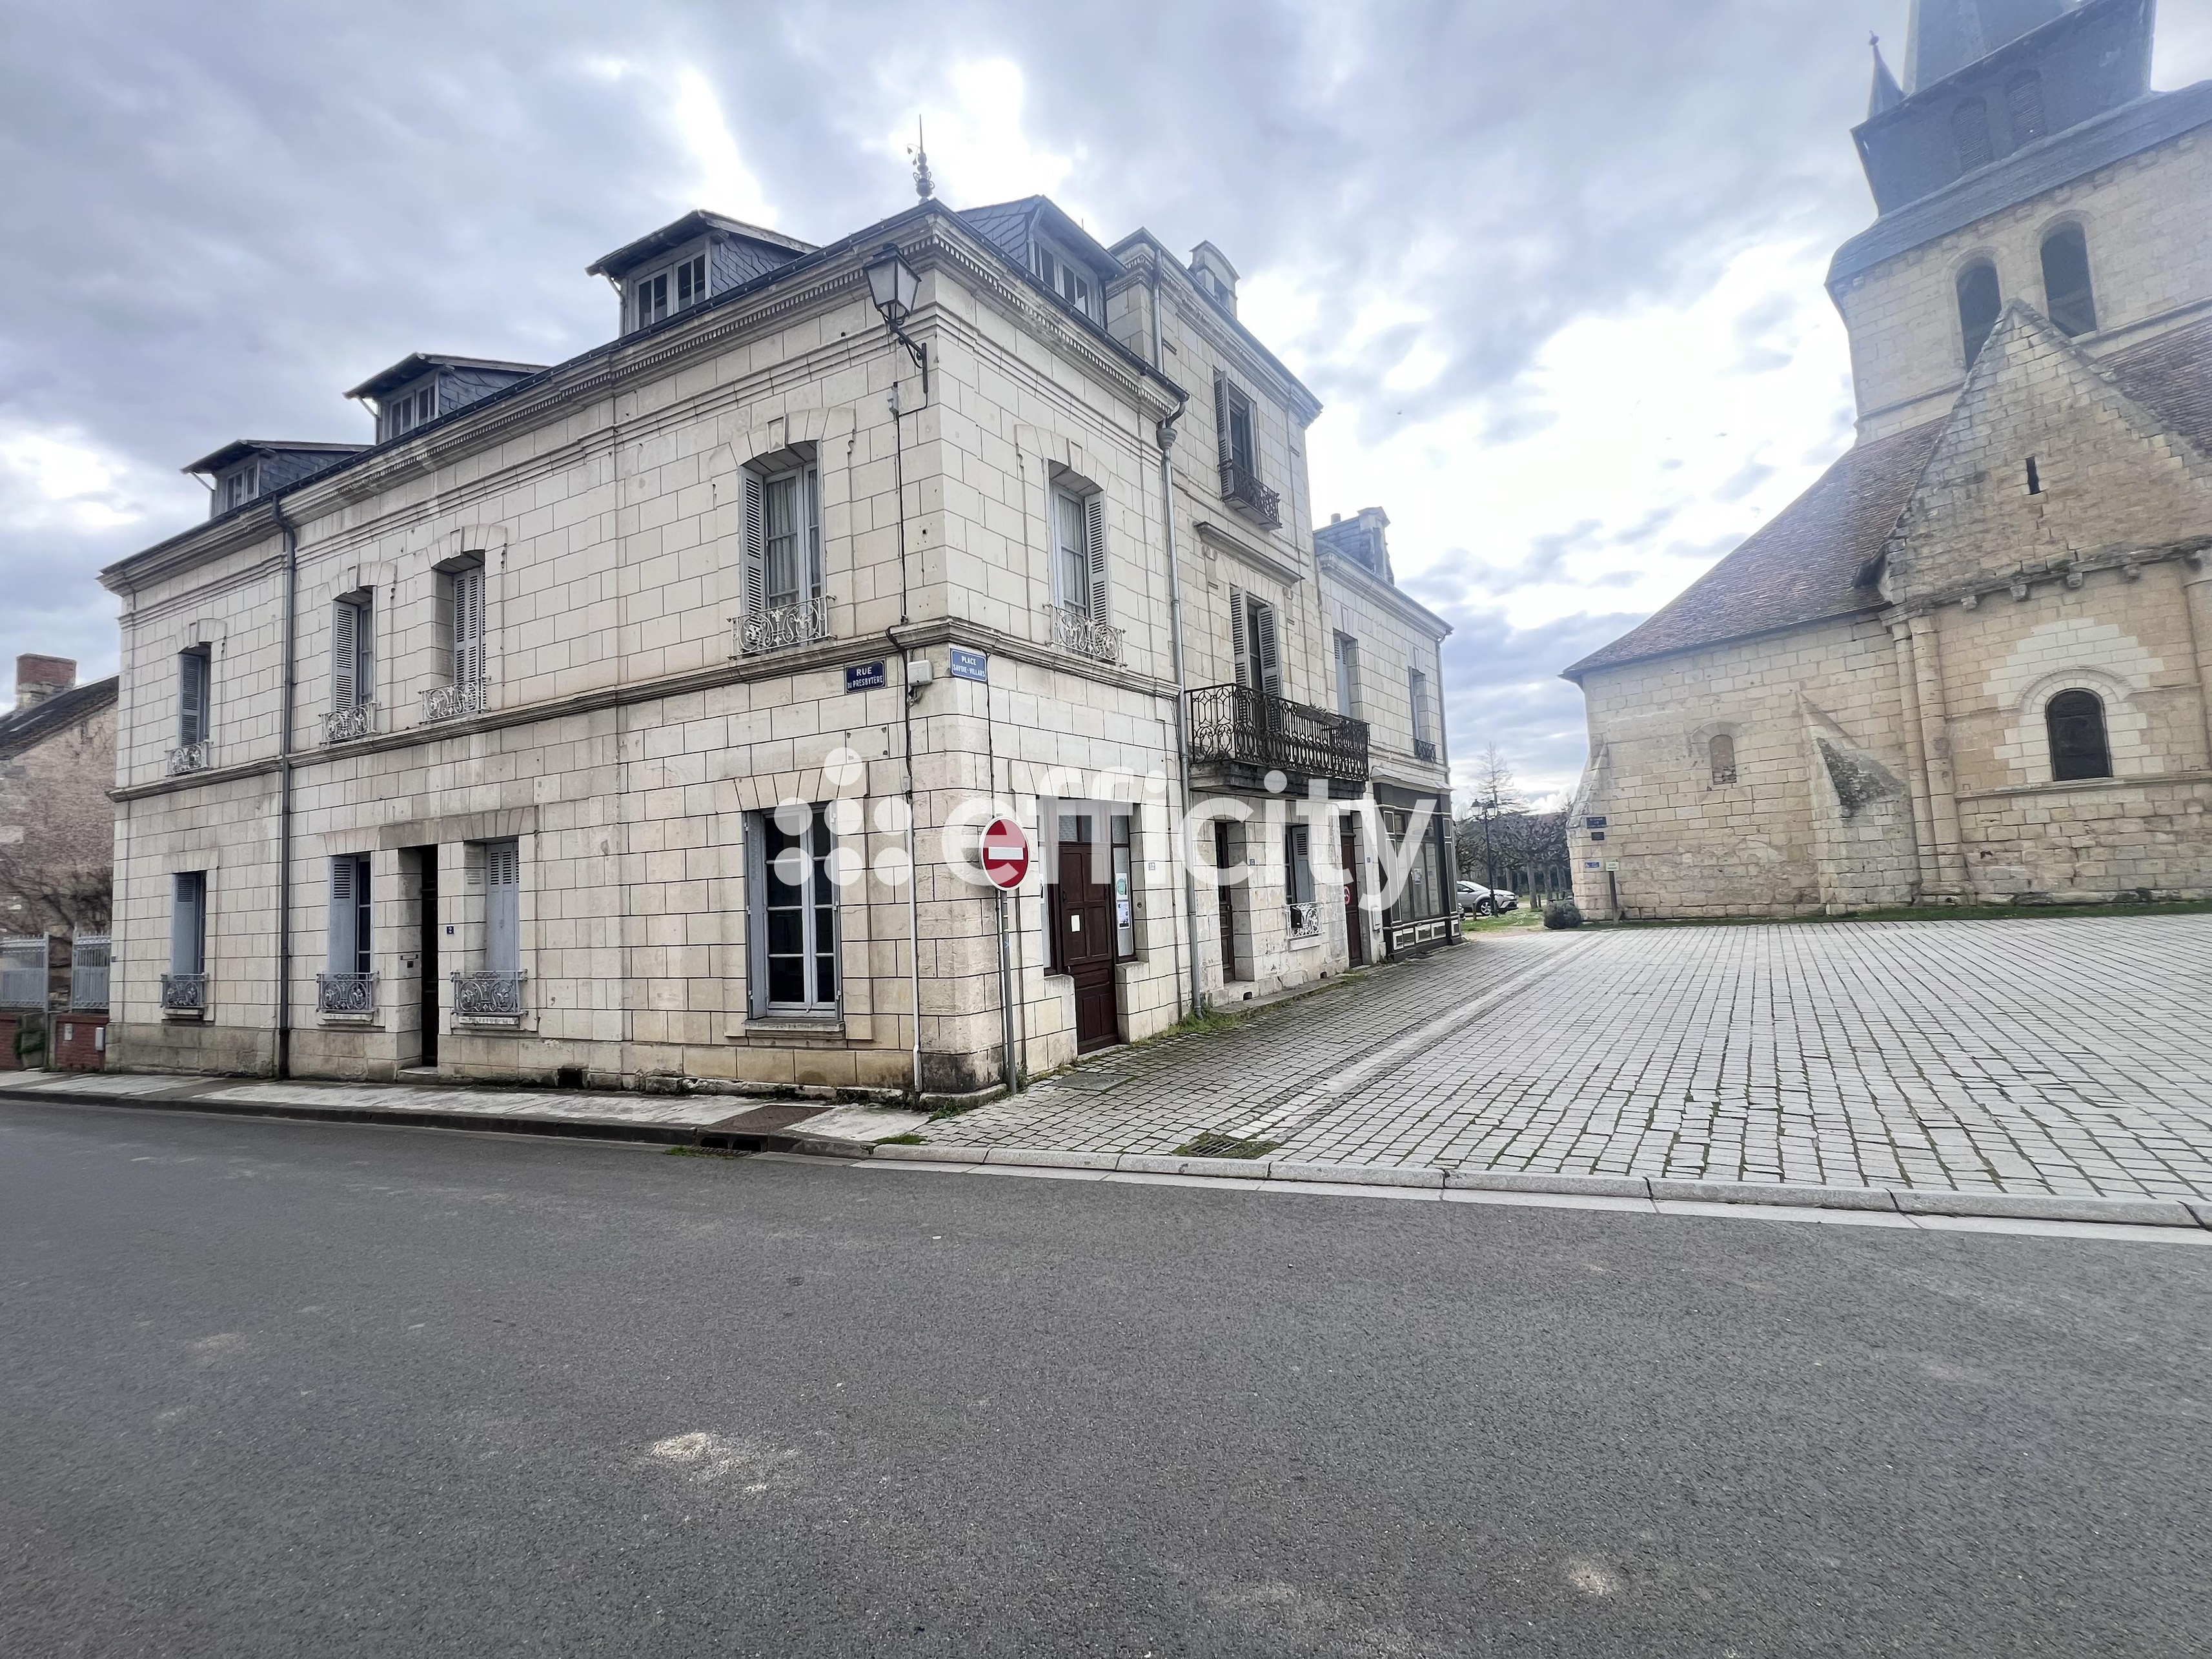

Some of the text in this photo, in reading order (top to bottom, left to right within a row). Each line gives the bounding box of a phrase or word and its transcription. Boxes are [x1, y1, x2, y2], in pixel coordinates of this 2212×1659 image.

[961, 655, 976, 666] PLACE
[856, 666, 873, 677] RUE
[853, 675, 884, 688] PRESBYTÈRE
